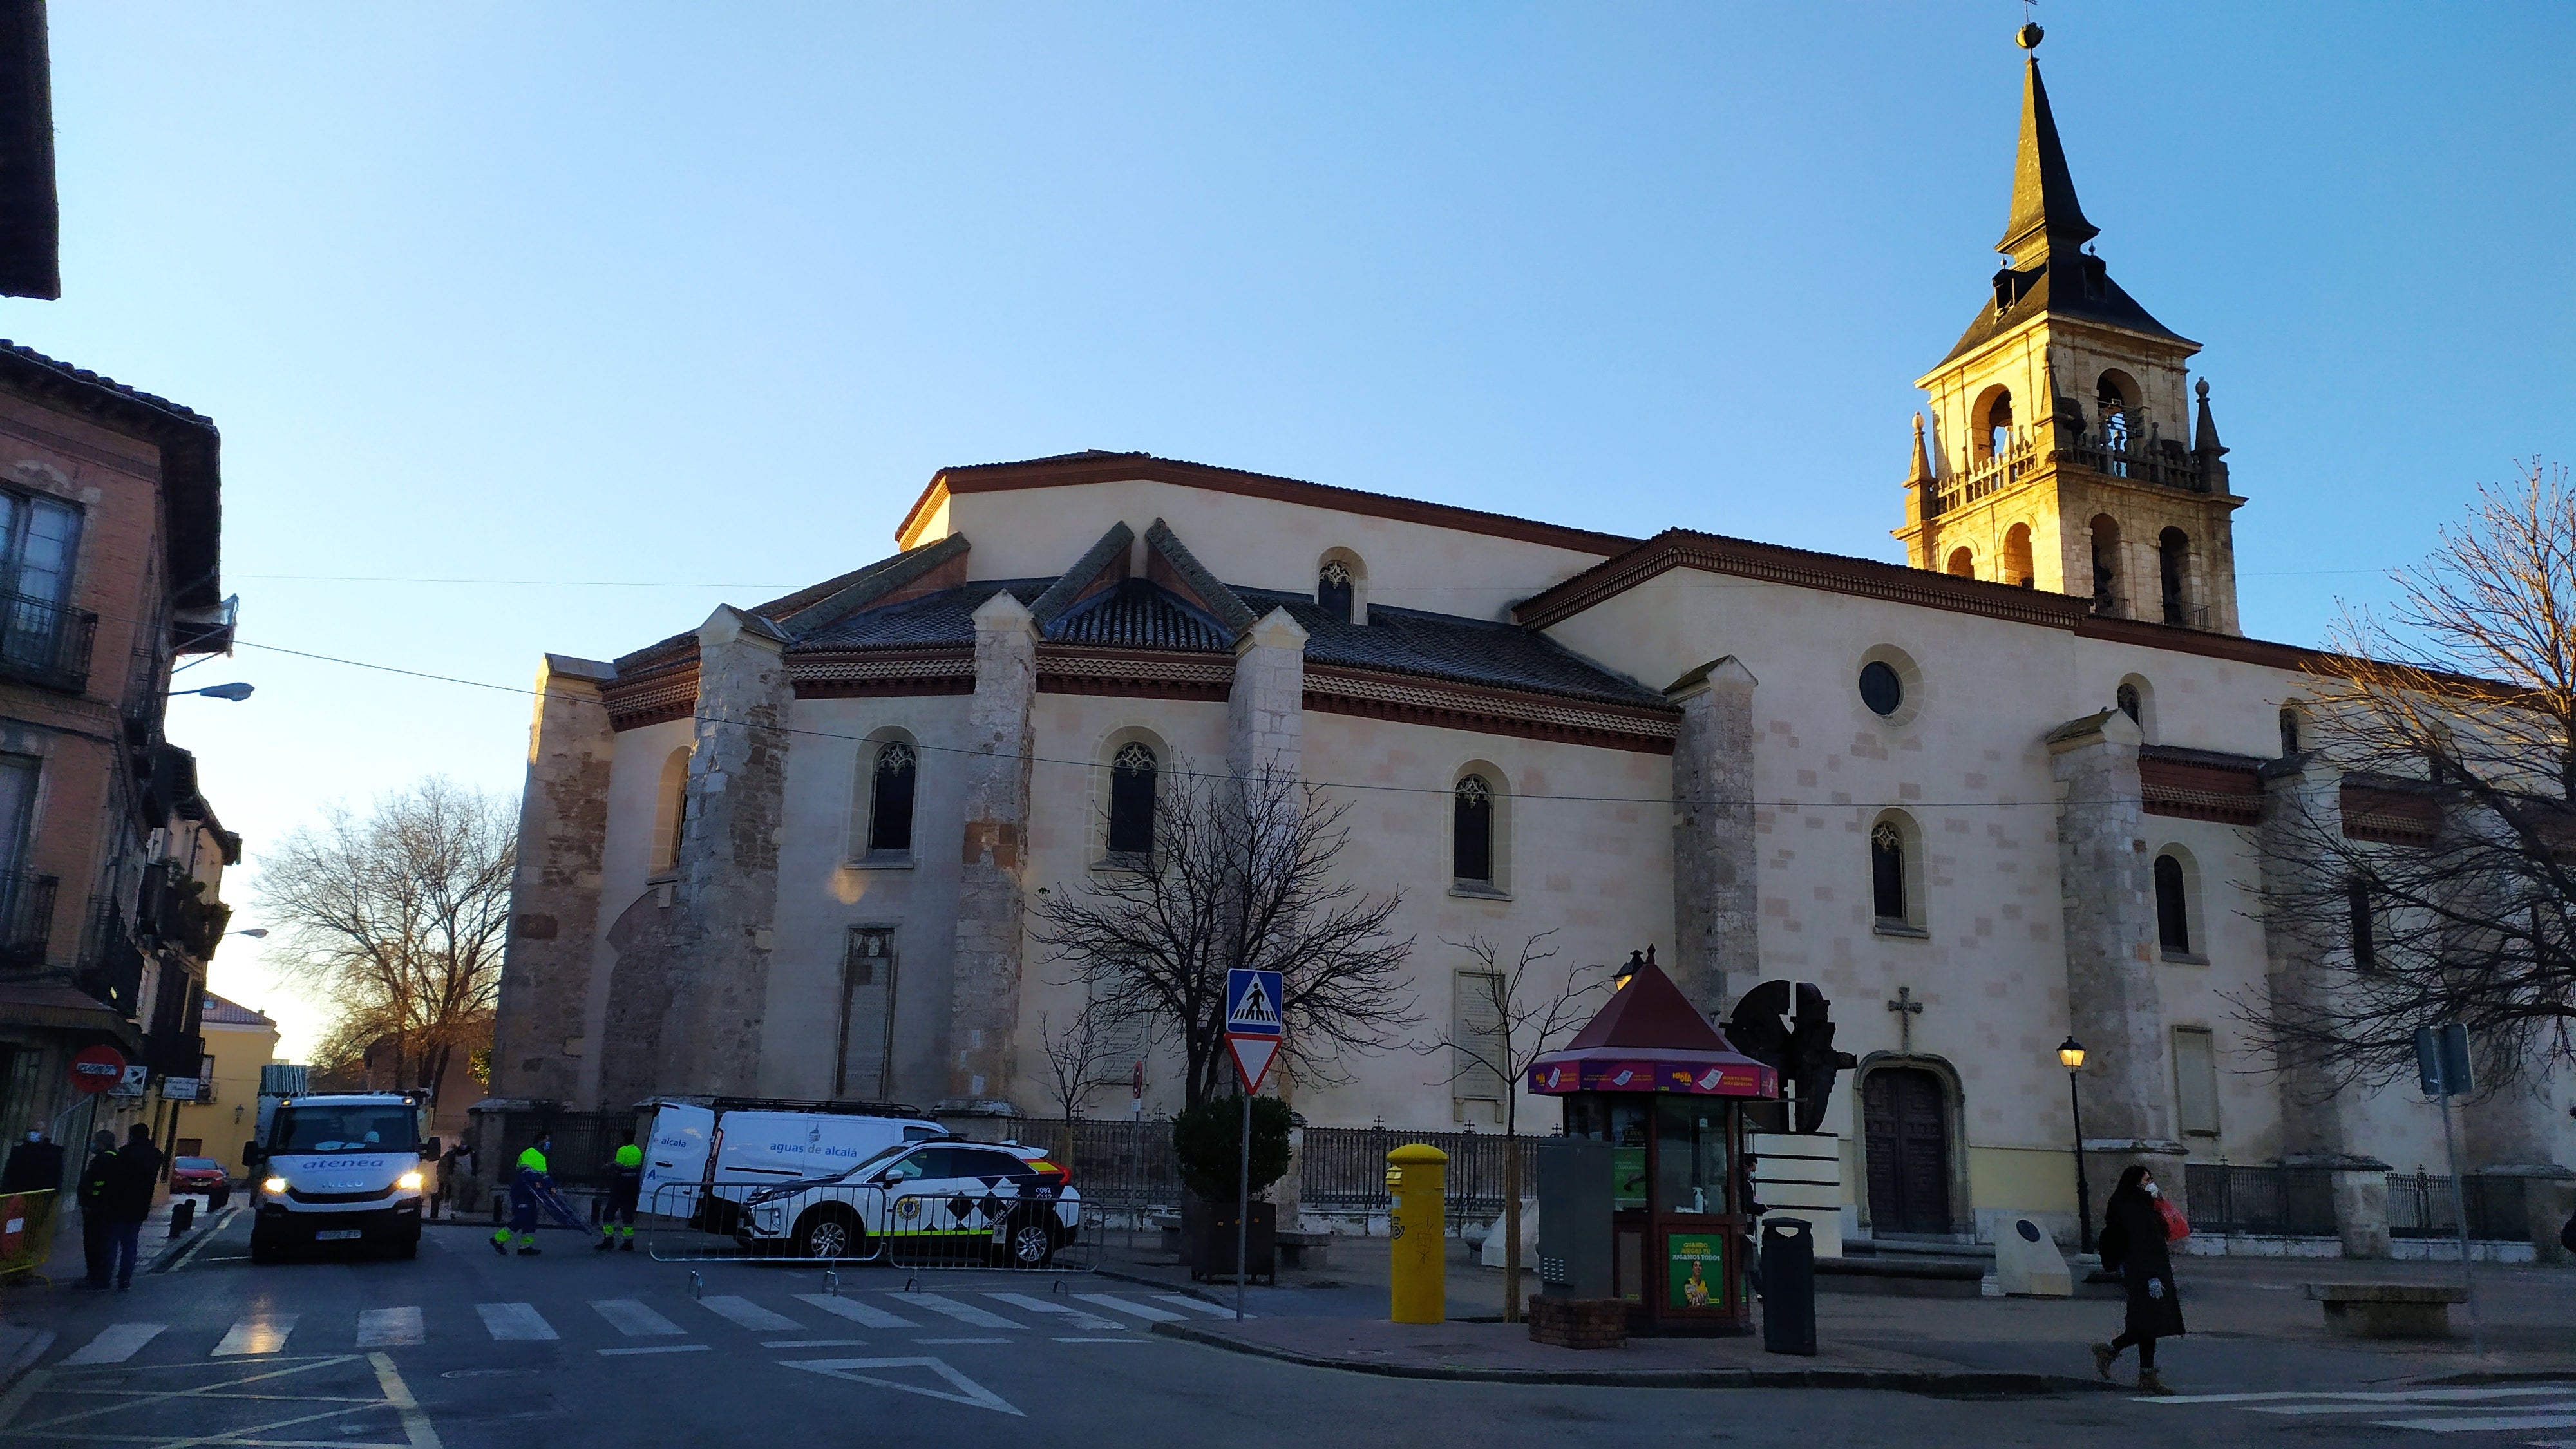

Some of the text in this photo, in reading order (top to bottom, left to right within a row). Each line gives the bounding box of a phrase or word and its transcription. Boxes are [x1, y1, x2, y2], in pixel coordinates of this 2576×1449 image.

[770, 1143, 857, 1158] aguas de alcalá
[303, 1159, 384, 1169] atenea
[321, 1180, 364, 1188] IVECO
